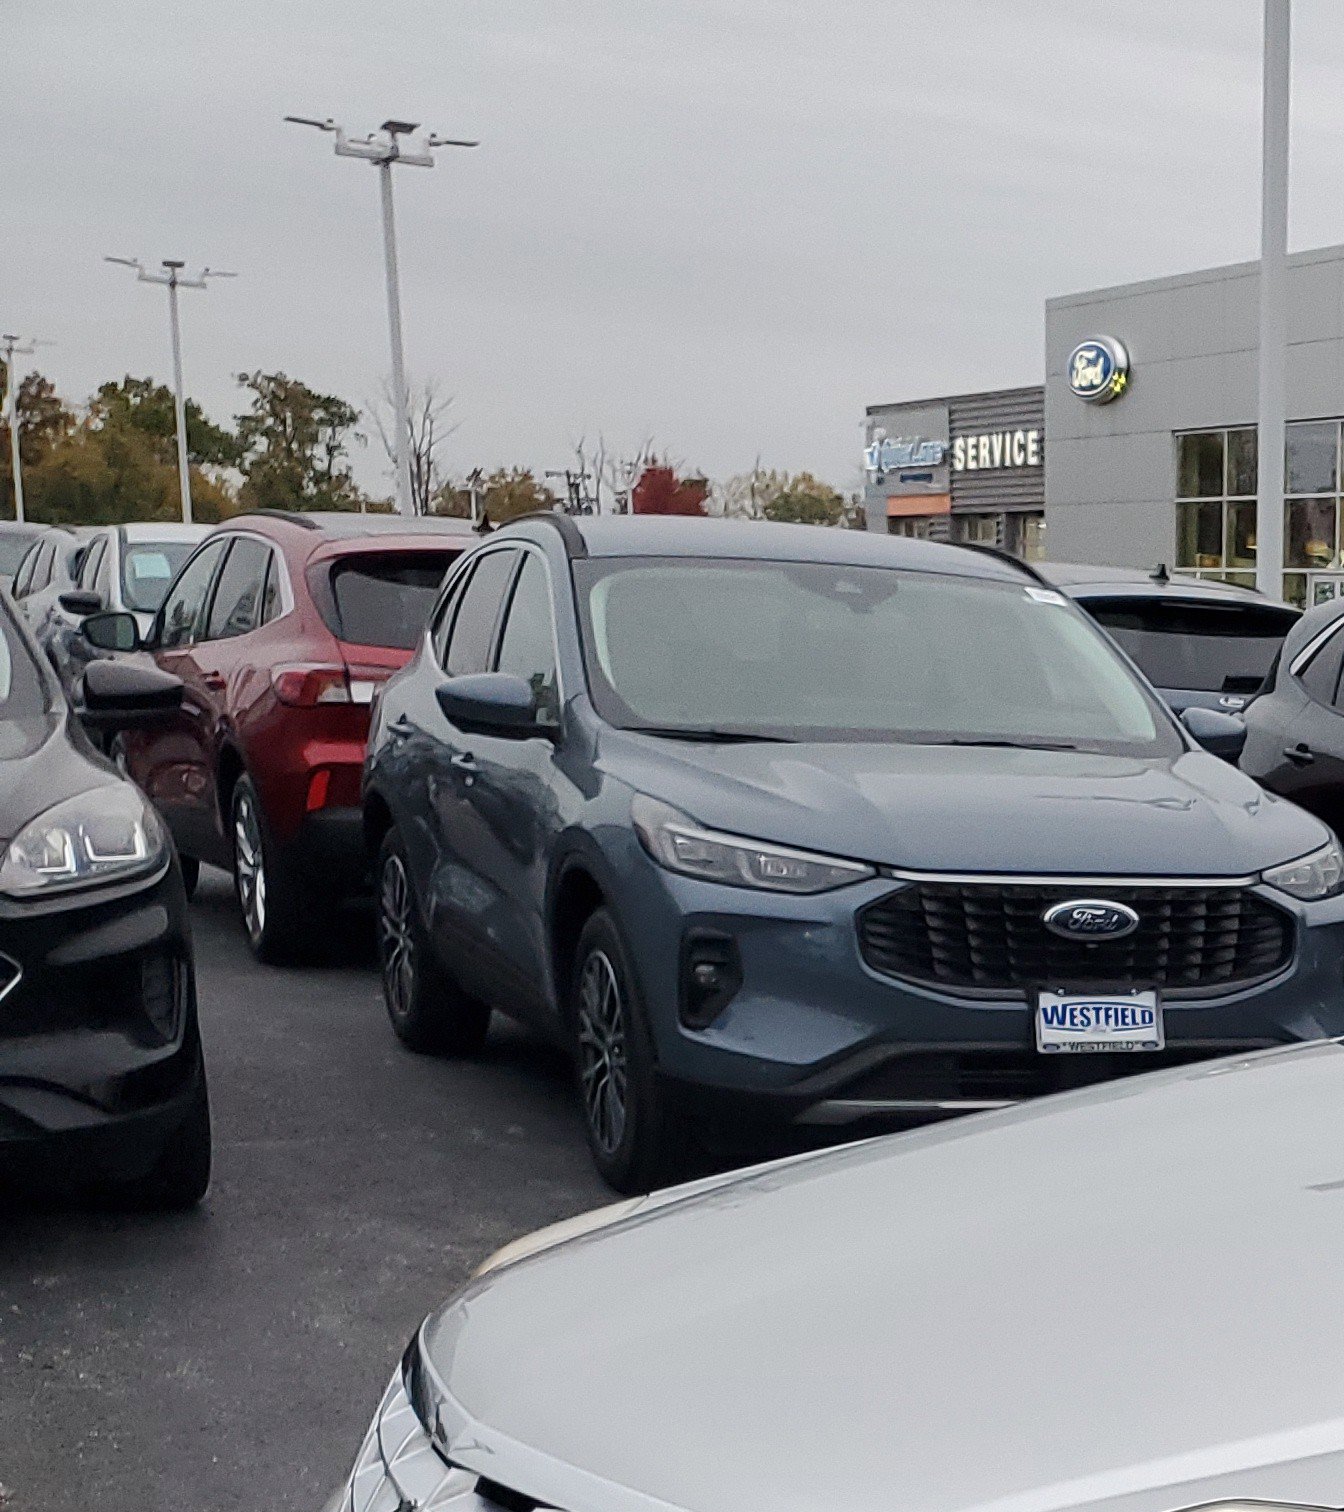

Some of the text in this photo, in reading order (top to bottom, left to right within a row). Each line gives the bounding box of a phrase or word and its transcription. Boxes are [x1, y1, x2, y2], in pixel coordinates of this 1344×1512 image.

[1071, 349, 1105, 388] Ford
[952, 429, 1041, 471] SERVICE
[1067, 908, 1119, 930] Ford
[1041, 1003, 1154, 1028] WESTFIELD
